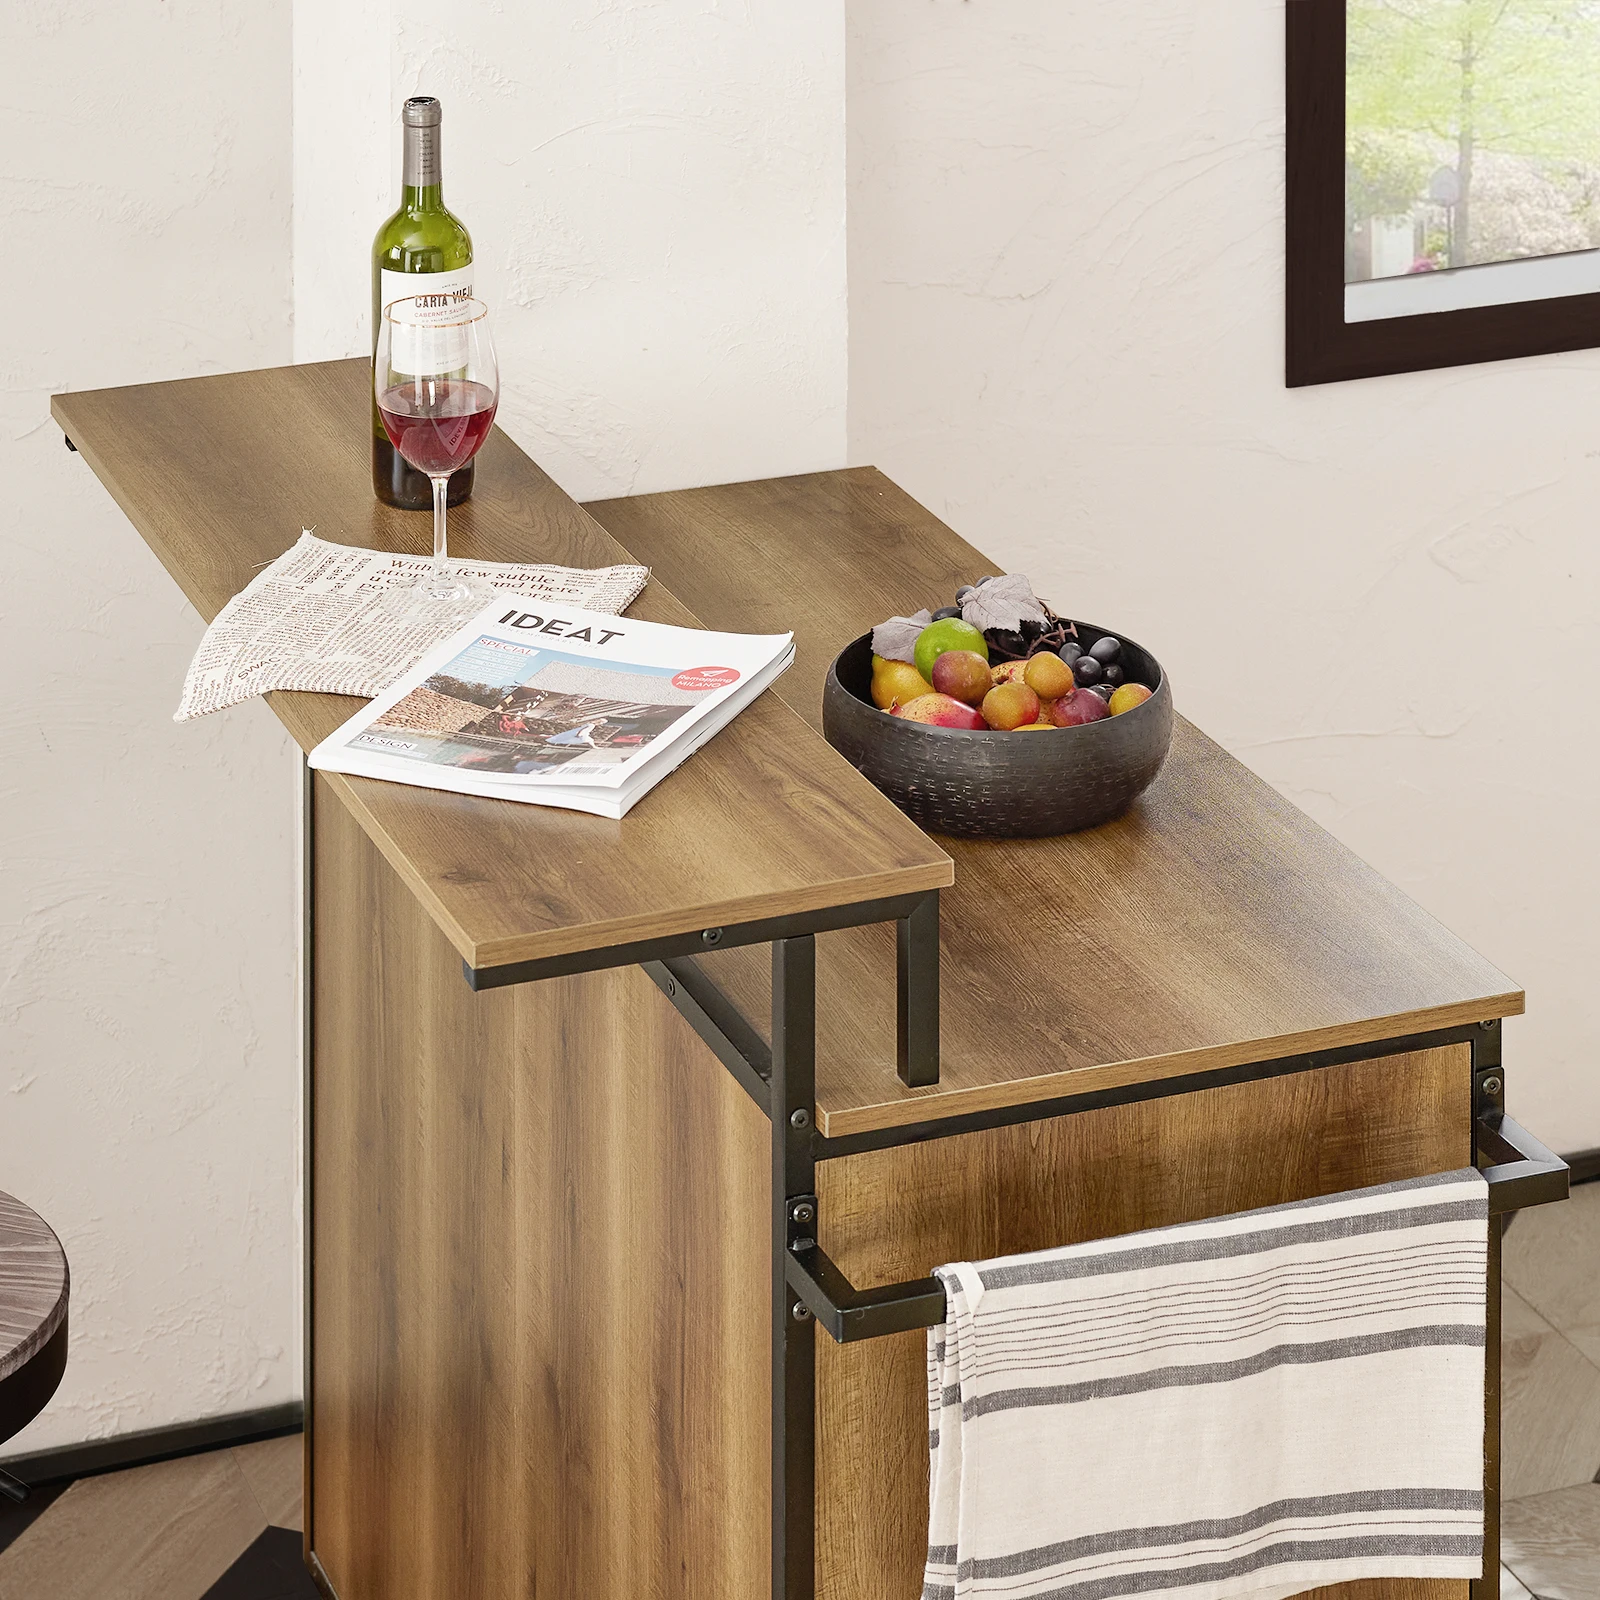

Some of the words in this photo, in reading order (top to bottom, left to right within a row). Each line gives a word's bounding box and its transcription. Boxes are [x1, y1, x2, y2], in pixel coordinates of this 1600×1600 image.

[414, 310, 447, 318] CABERNET
[391, 560, 432, 571] With
[455, 568, 492, 578] few
[495, 573, 555, 584] subtle
[530, 584, 584, 595] there.
[498, 609, 626, 645] IDEAT
[677, 674, 733, 683] Remapping
[360, 734, 413, 749] DESIGN
